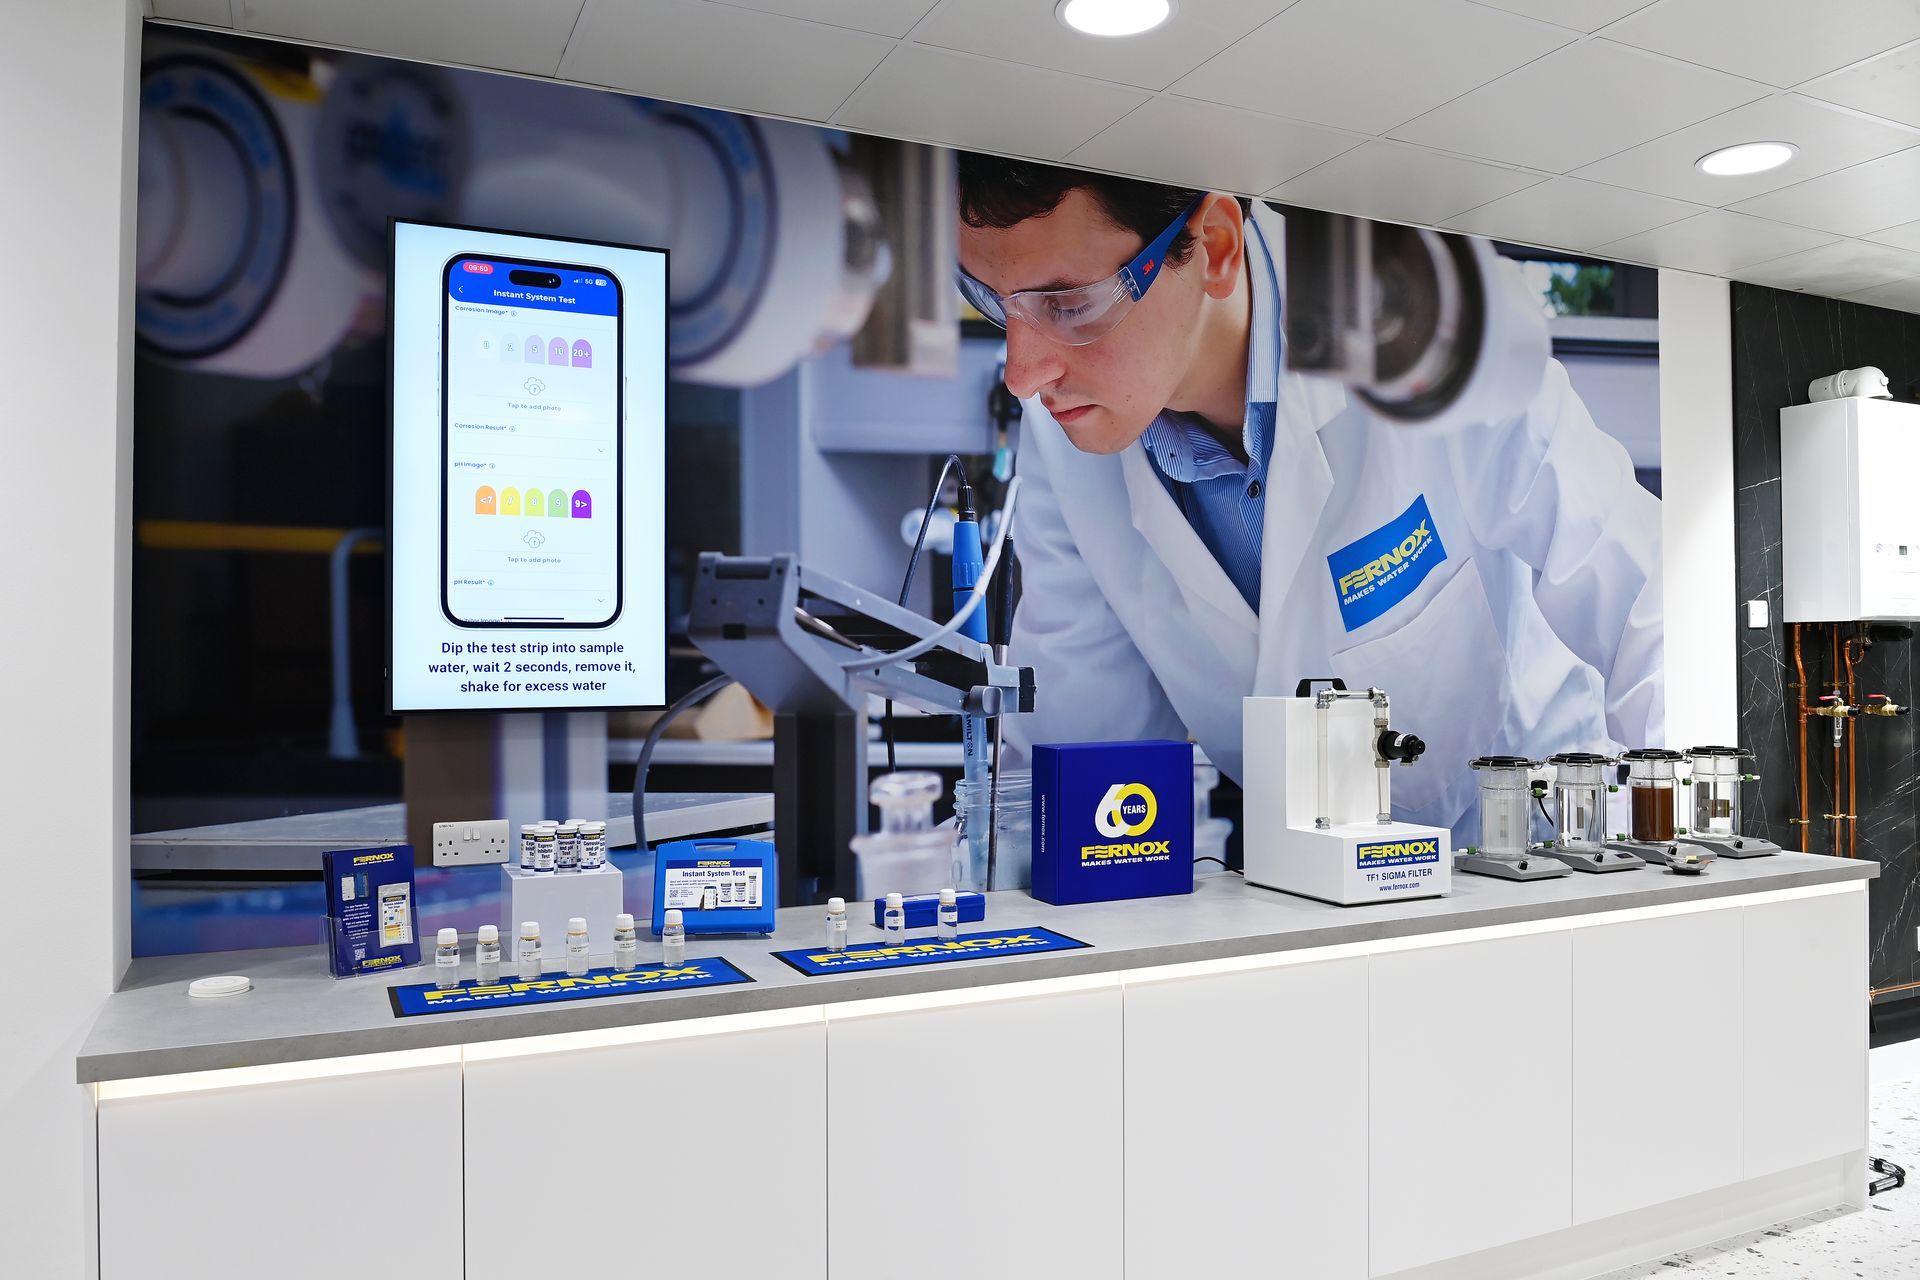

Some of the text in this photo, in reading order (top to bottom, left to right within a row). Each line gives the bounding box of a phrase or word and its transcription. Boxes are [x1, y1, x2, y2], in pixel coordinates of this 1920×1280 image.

[468, 264, 488, 273] 09:50
[493, 289, 576, 305] Instant System Test
[454, 305, 485, 313] Corrosion
[531, 345, 538, 353] 5
[554, 347, 564, 356] 10
[573, 349, 590, 358] 20+
[508, 402, 519, 410] Tap
[480, 495, 493, 504] <7
[555, 498, 561, 507] 9
[575, 499, 588, 508] 9>
[507, 556, 519, 564] Tap
[1339, 518, 1431, 596] FERNOX
[1344, 535, 1433, 606] MAKES WATER WORK
[441, 641, 624, 656] Dip the test strip into sample
[428, 660, 636, 675] water, wait 2 seconds, remove it,
[460, 680, 607, 693] shake for excess water
[1122, 804, 1147, 815] YEARS
[1081, 840, 1170, 860] FERNOX
[1359, 840, 1437, 859] FERNOX
[353, 852, 394, 863] FERNOX
[1081, 854, 1170, 868] MAKES WATER WORK
[1359, 854, 1437, 867] MAKES WATER WORK
[707, 870, 730, 878] System
[1366, 868, 1433, 882] TF1 SIGMA FILTER
[1379, 881, 1420, 892] www.fernox.com
[808, 934, 1045, 964] FERNOX
[819, 940, 1052, 967] MAKES WATER WORK
[362, 954, 402, 967] FERNOX
[424, 965, 710, 1000] FERNOX
[427, 973, 713, 1005] MAKES WATER WORK
